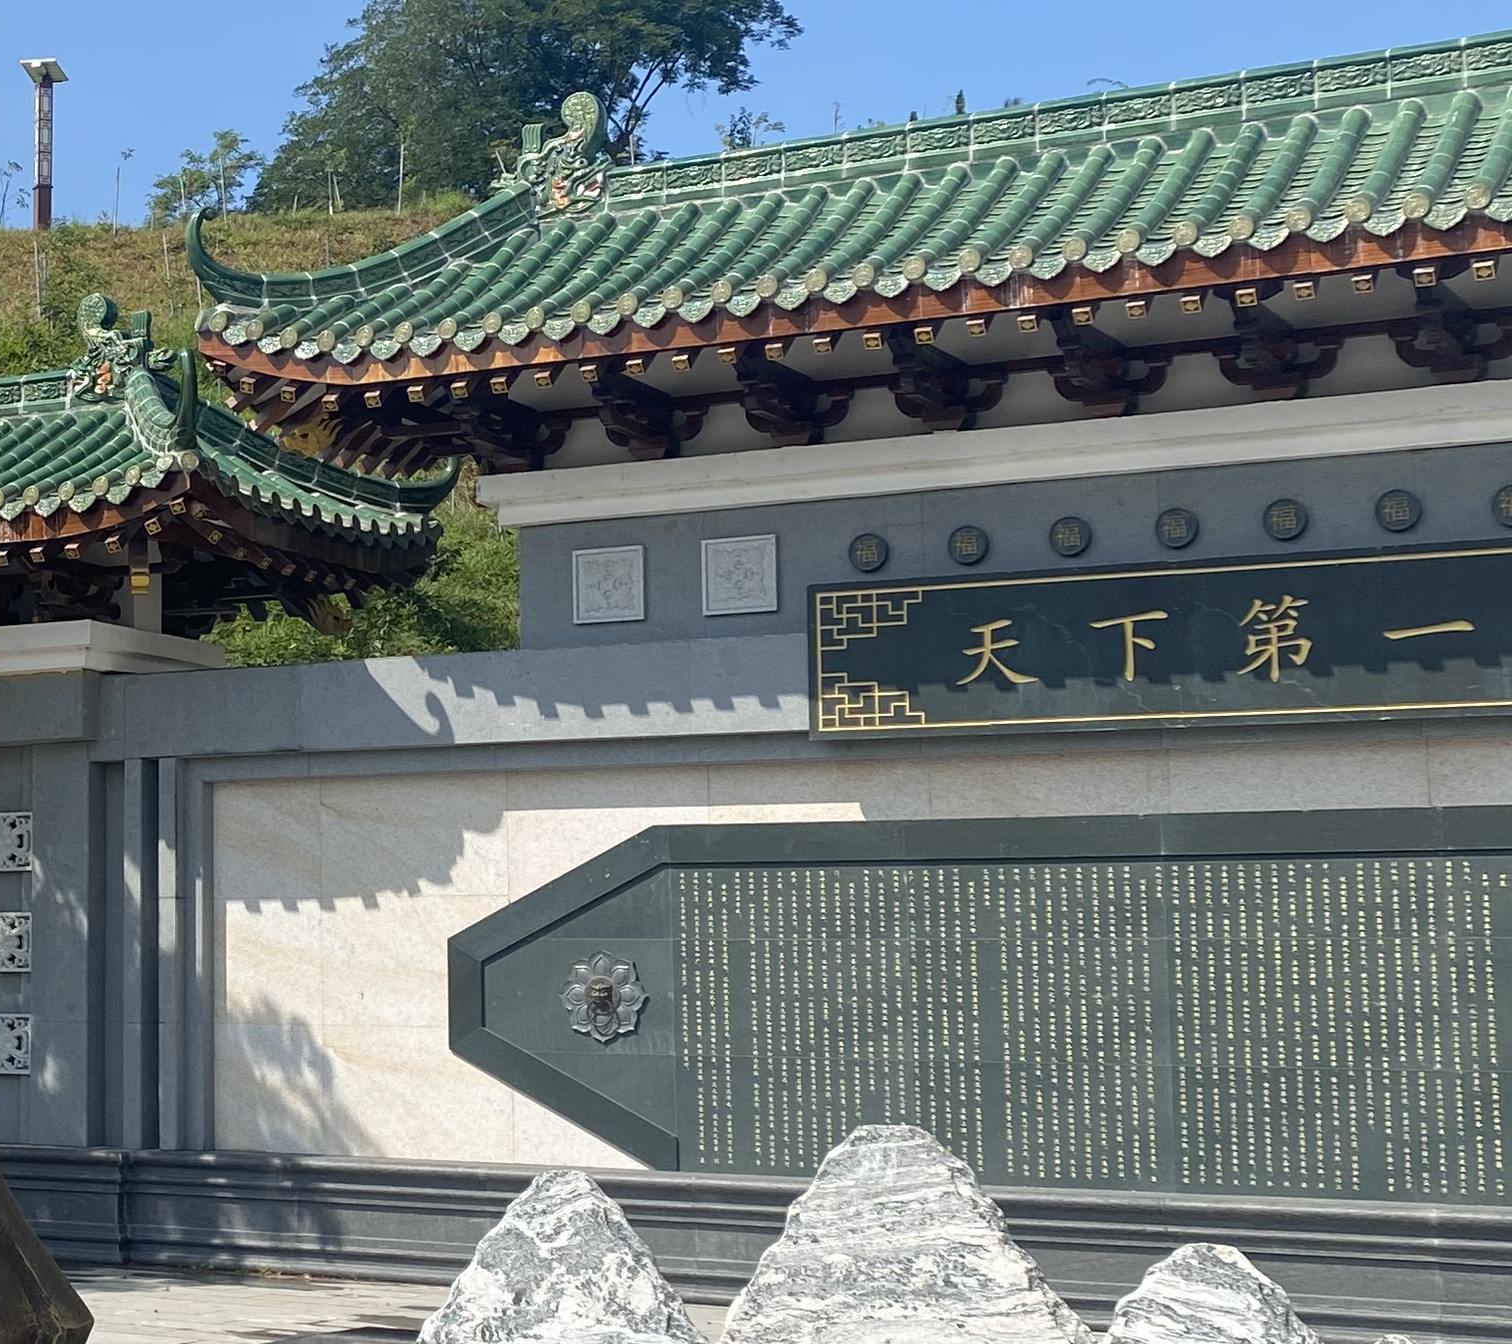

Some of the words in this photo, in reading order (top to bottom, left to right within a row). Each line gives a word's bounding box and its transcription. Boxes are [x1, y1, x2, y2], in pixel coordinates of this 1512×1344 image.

[1270, 506, 1297, 530] 福
[1383, 497, 1410, 522] 福
[1055, 523, 1081, 547] 福
[1162, 515, 1188, 539] 福
[855, 540, 879, 563] 福
[954, 532, 978, 556] 福
[955, 593, 1476, 686] 天下第一
